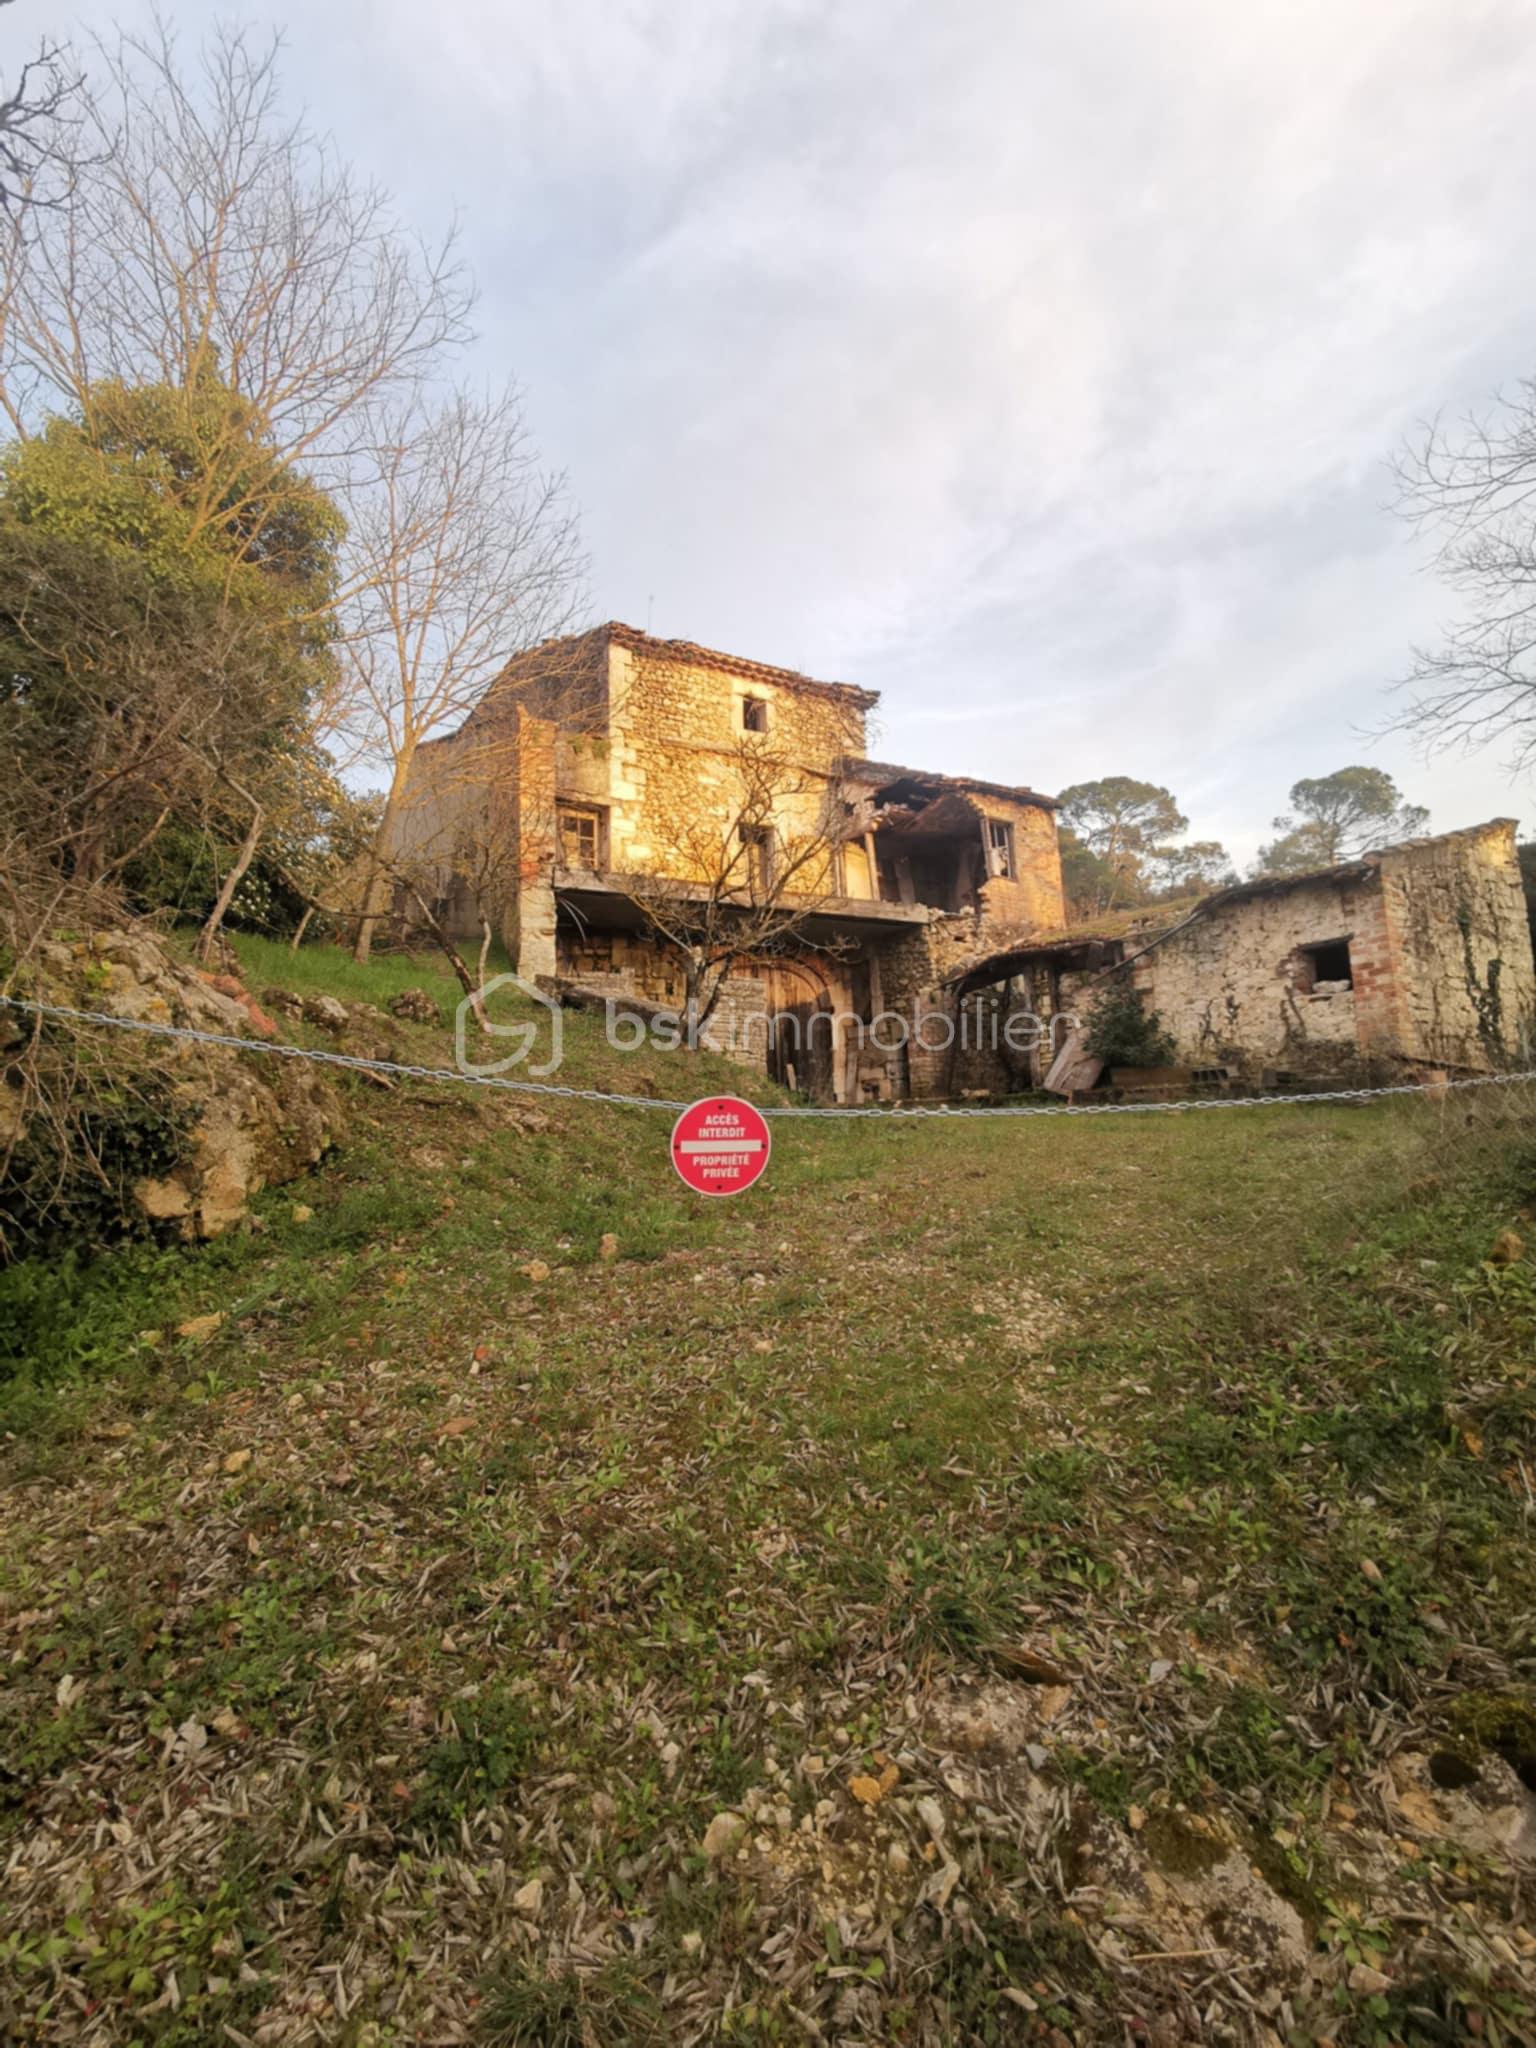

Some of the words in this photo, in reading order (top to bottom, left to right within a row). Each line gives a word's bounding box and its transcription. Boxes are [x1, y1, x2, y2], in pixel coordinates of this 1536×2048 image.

[698, 1127, 745, 1137] INTERDIT
[692, 1153, 750, 1165] PROPRIÉTÉ
[703, 1166, 740, 1177] PRIVÉE
